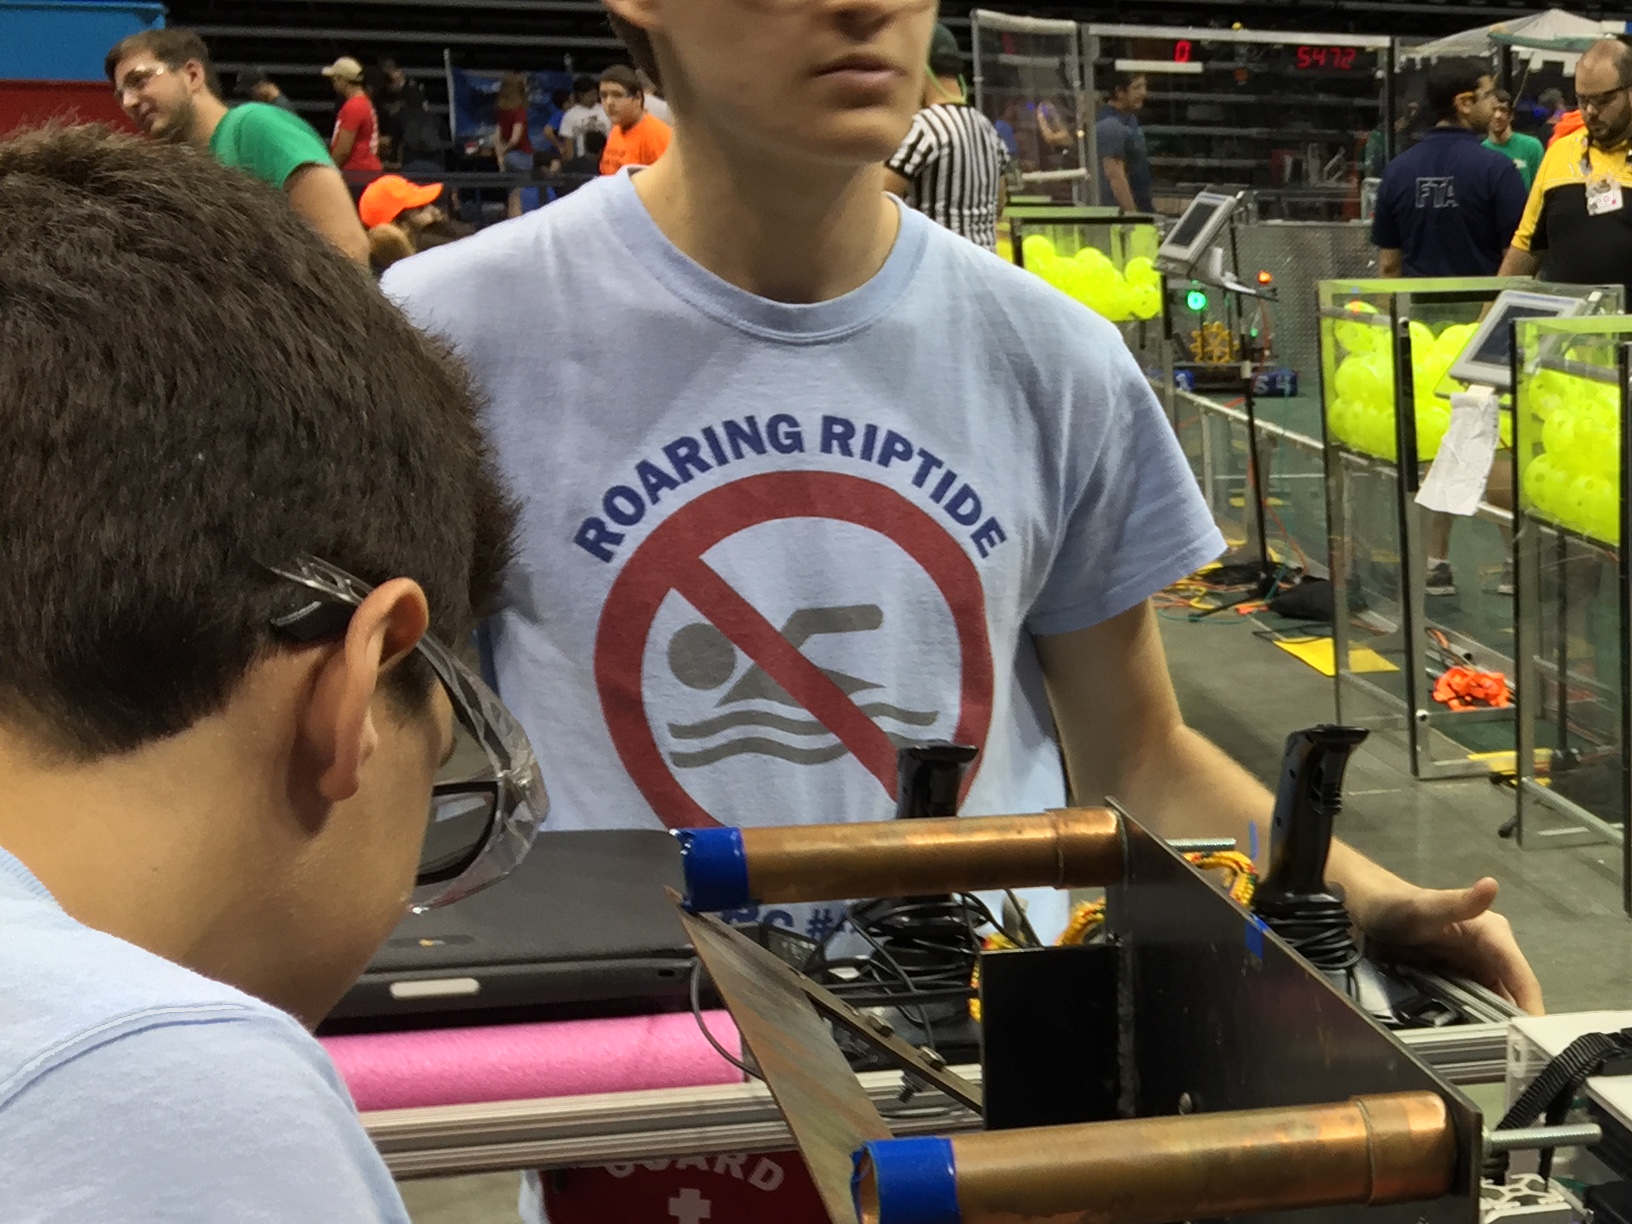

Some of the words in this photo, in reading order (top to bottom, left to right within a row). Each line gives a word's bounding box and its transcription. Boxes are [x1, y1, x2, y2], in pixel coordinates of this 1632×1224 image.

[1415, 176, 1460, 208] FTA
[573, 413, 805, 564] ROARING
[819, 414, 1008, 559] RIPTIDE
